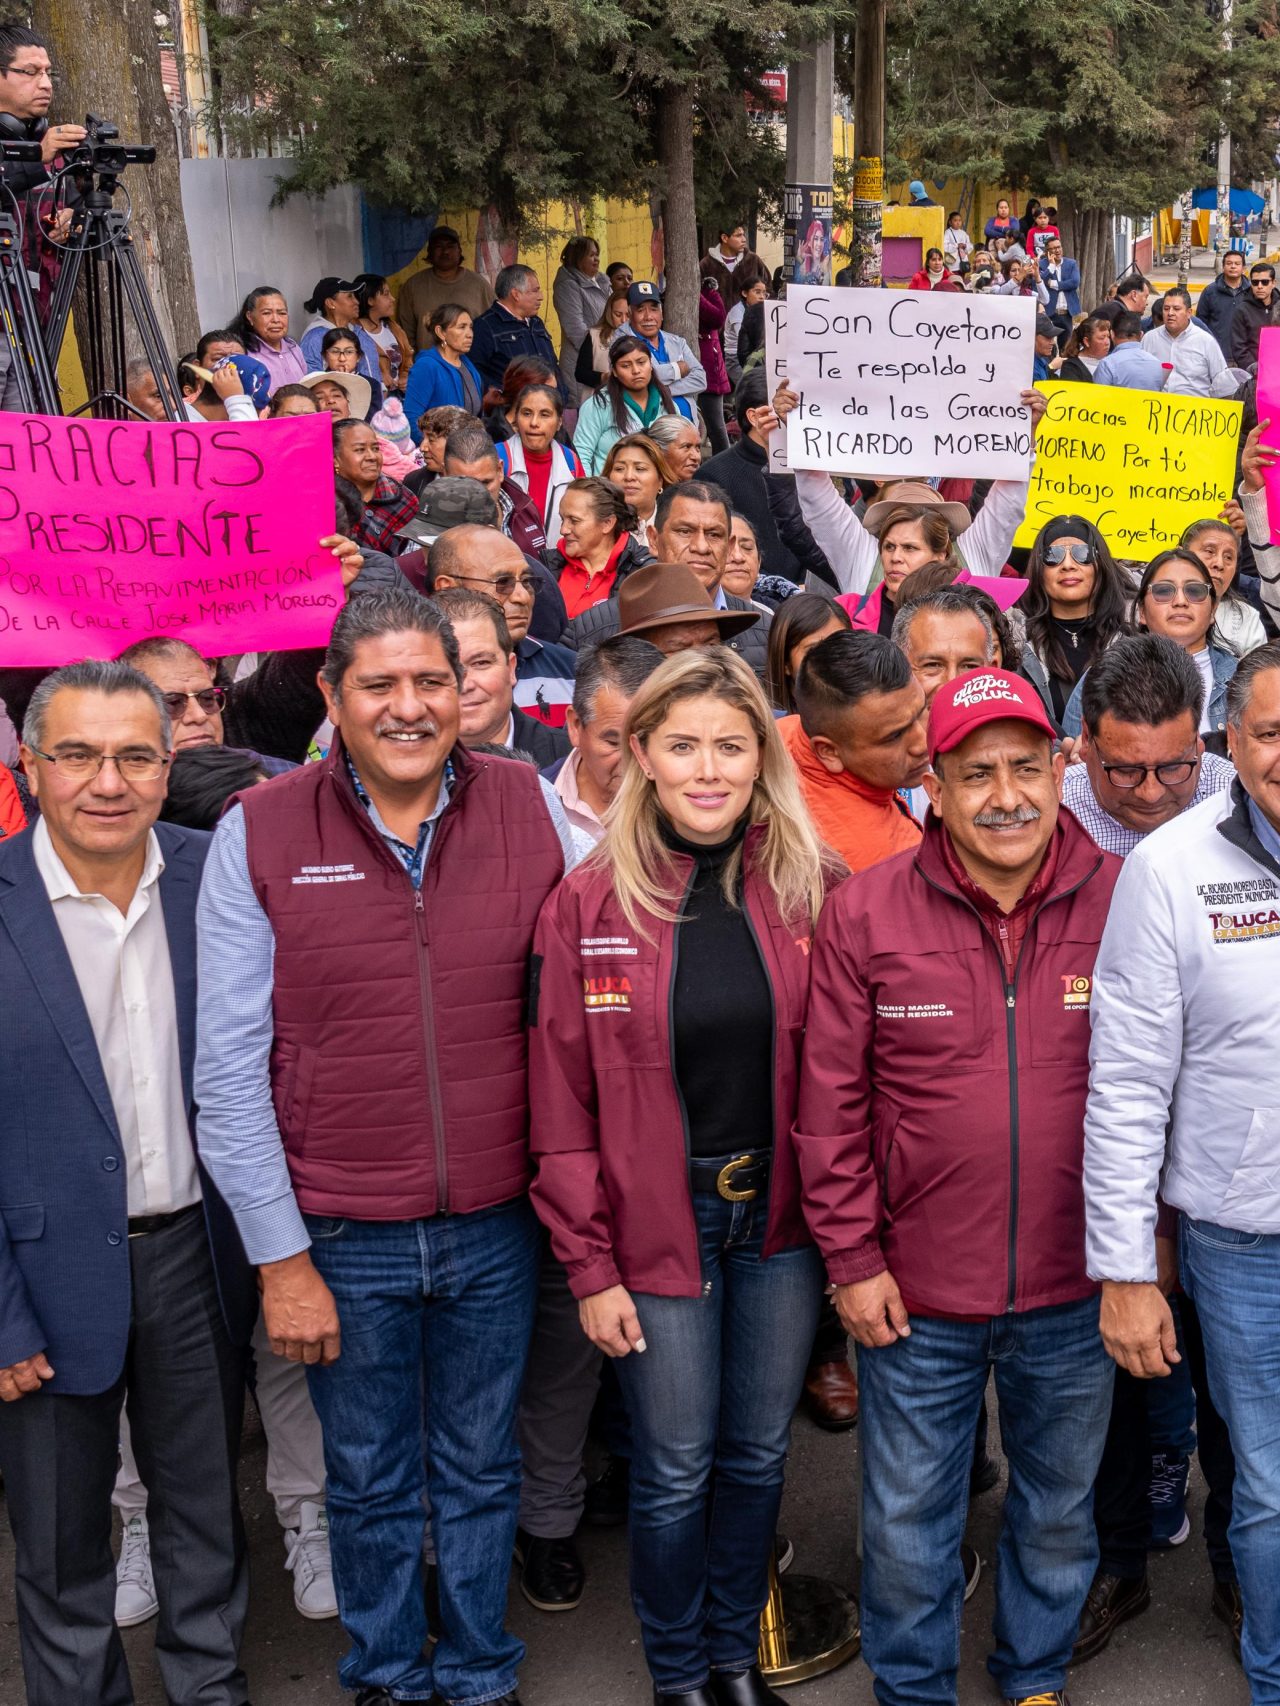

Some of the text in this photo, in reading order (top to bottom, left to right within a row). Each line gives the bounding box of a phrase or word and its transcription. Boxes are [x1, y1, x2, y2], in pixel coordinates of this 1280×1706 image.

[804, 297, 872, 336] San
[888, 298, 1023, 350] Cayetano
[803, 350, 843, 379] Te
[857, 354, 967, 384] respalda
[796, 391, 1029, 421] te da las Gracias
[1045, 389, 1240, 440] Gracias RICARDO
[803, 427, 914, 459] RICARDO
[934, 430, 1031, 457] MORENO
[1123, 443, 1151, 469] Por
[1159, 446, 1188, 473] tú
[1031, 467, 1228, 504] trabajo incansable
[1096, 509, 1183, 547] Cayetan
[57, 573, 92, 598] LA
[35, 614, 60, 631] LA
[70, 609, 130, 630] CALLE
[143, 602, 191, 632] JOSE
[198, 598, 258, 626] MARIA
[262, 592, 338, 613] MORELOS
[962, 689, 1024, 708] TOLUCA
[1203, 889, 1279, 906] PRESIDENTE MUNICIPAL
[1208, 882, 1233, 895] RICARDO
[1233, 880, 1258, 893] MORENO
[1214, 925, 1280, 937] CAPITAL
[907, 1003, 946, 1011] MAGNO
[907, 1010, 954, 1018] REGIDOR
